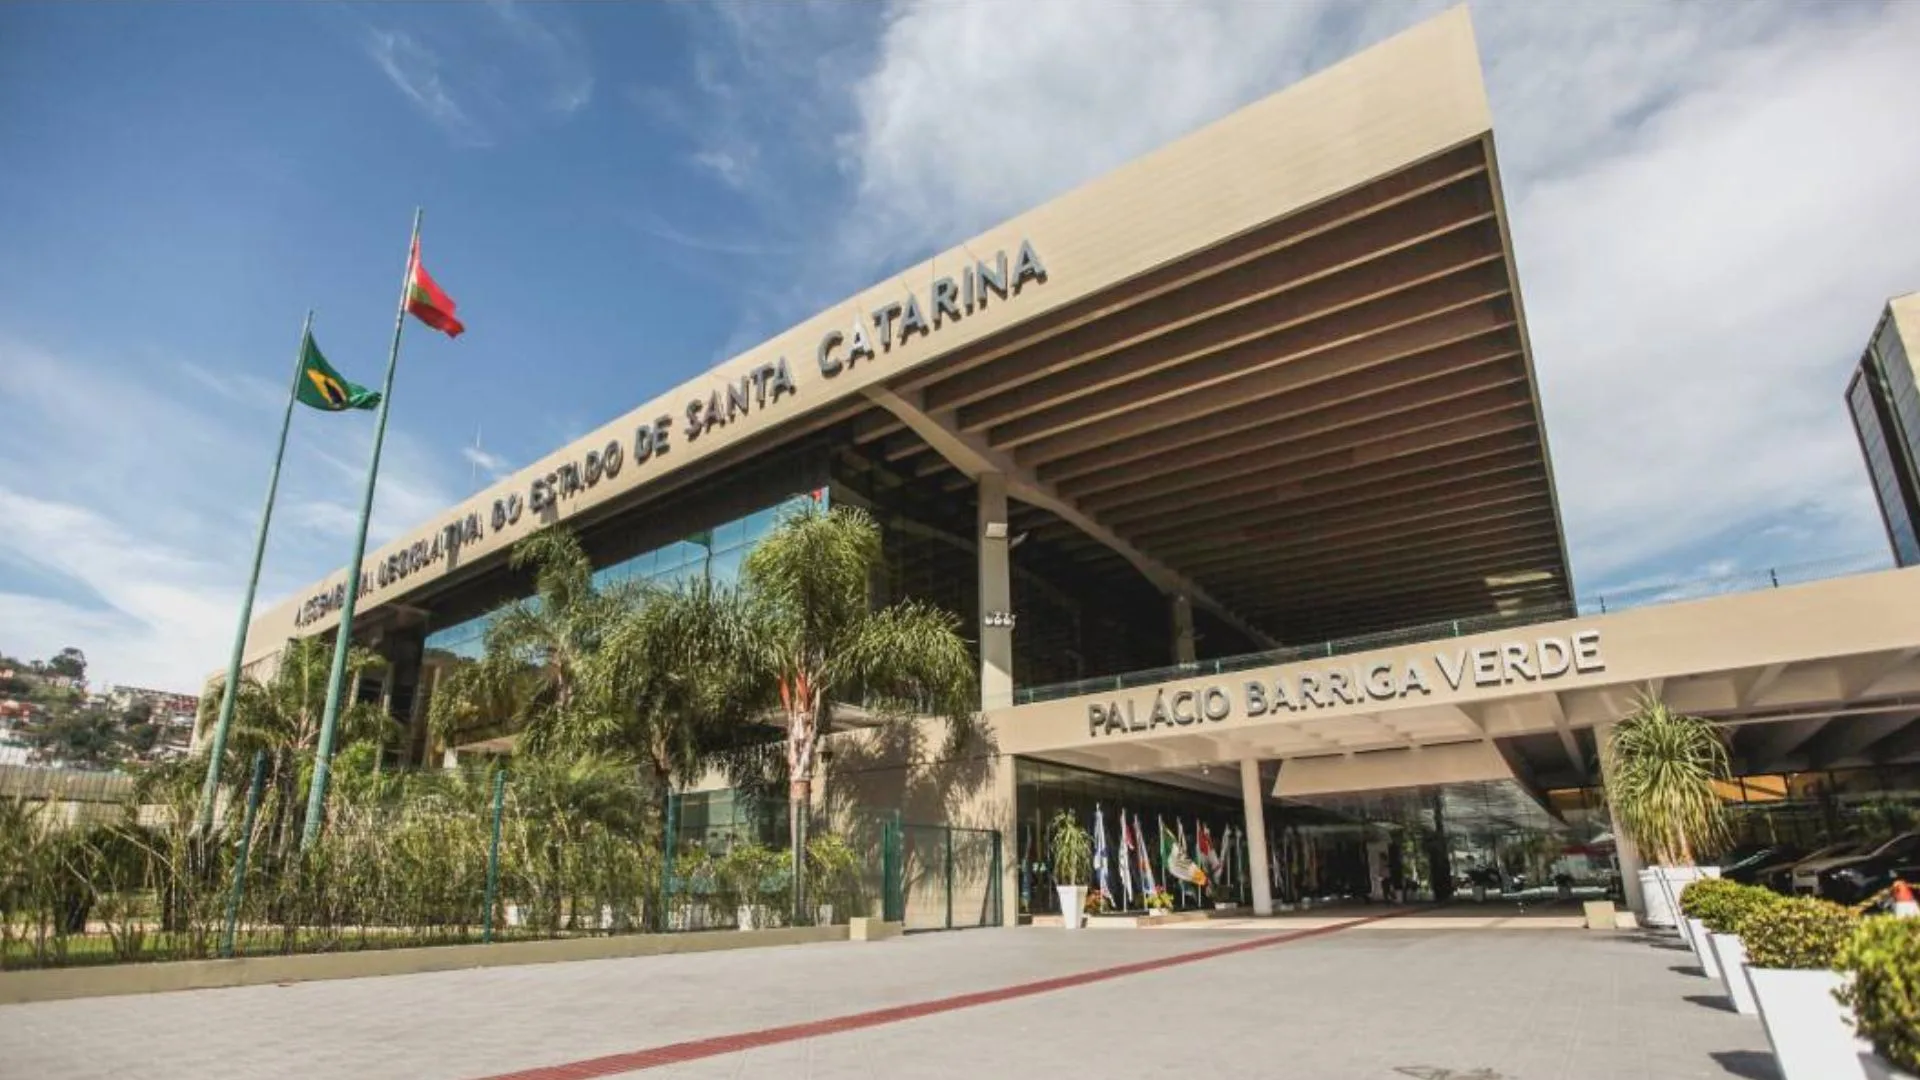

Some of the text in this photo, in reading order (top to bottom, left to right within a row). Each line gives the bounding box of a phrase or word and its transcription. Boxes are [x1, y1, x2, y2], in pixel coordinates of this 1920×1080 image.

[491, 493, 523, 531] DO
[529, 439, 624, 514] ESTADO
[634, 415, 671, 465] DE
[684, 355, 797, 441] SANTA
[817, 239, 1049, 379] CATARINA
[1088, 630, 1605, 736] PALÁCIO BARRIGA VERDE
